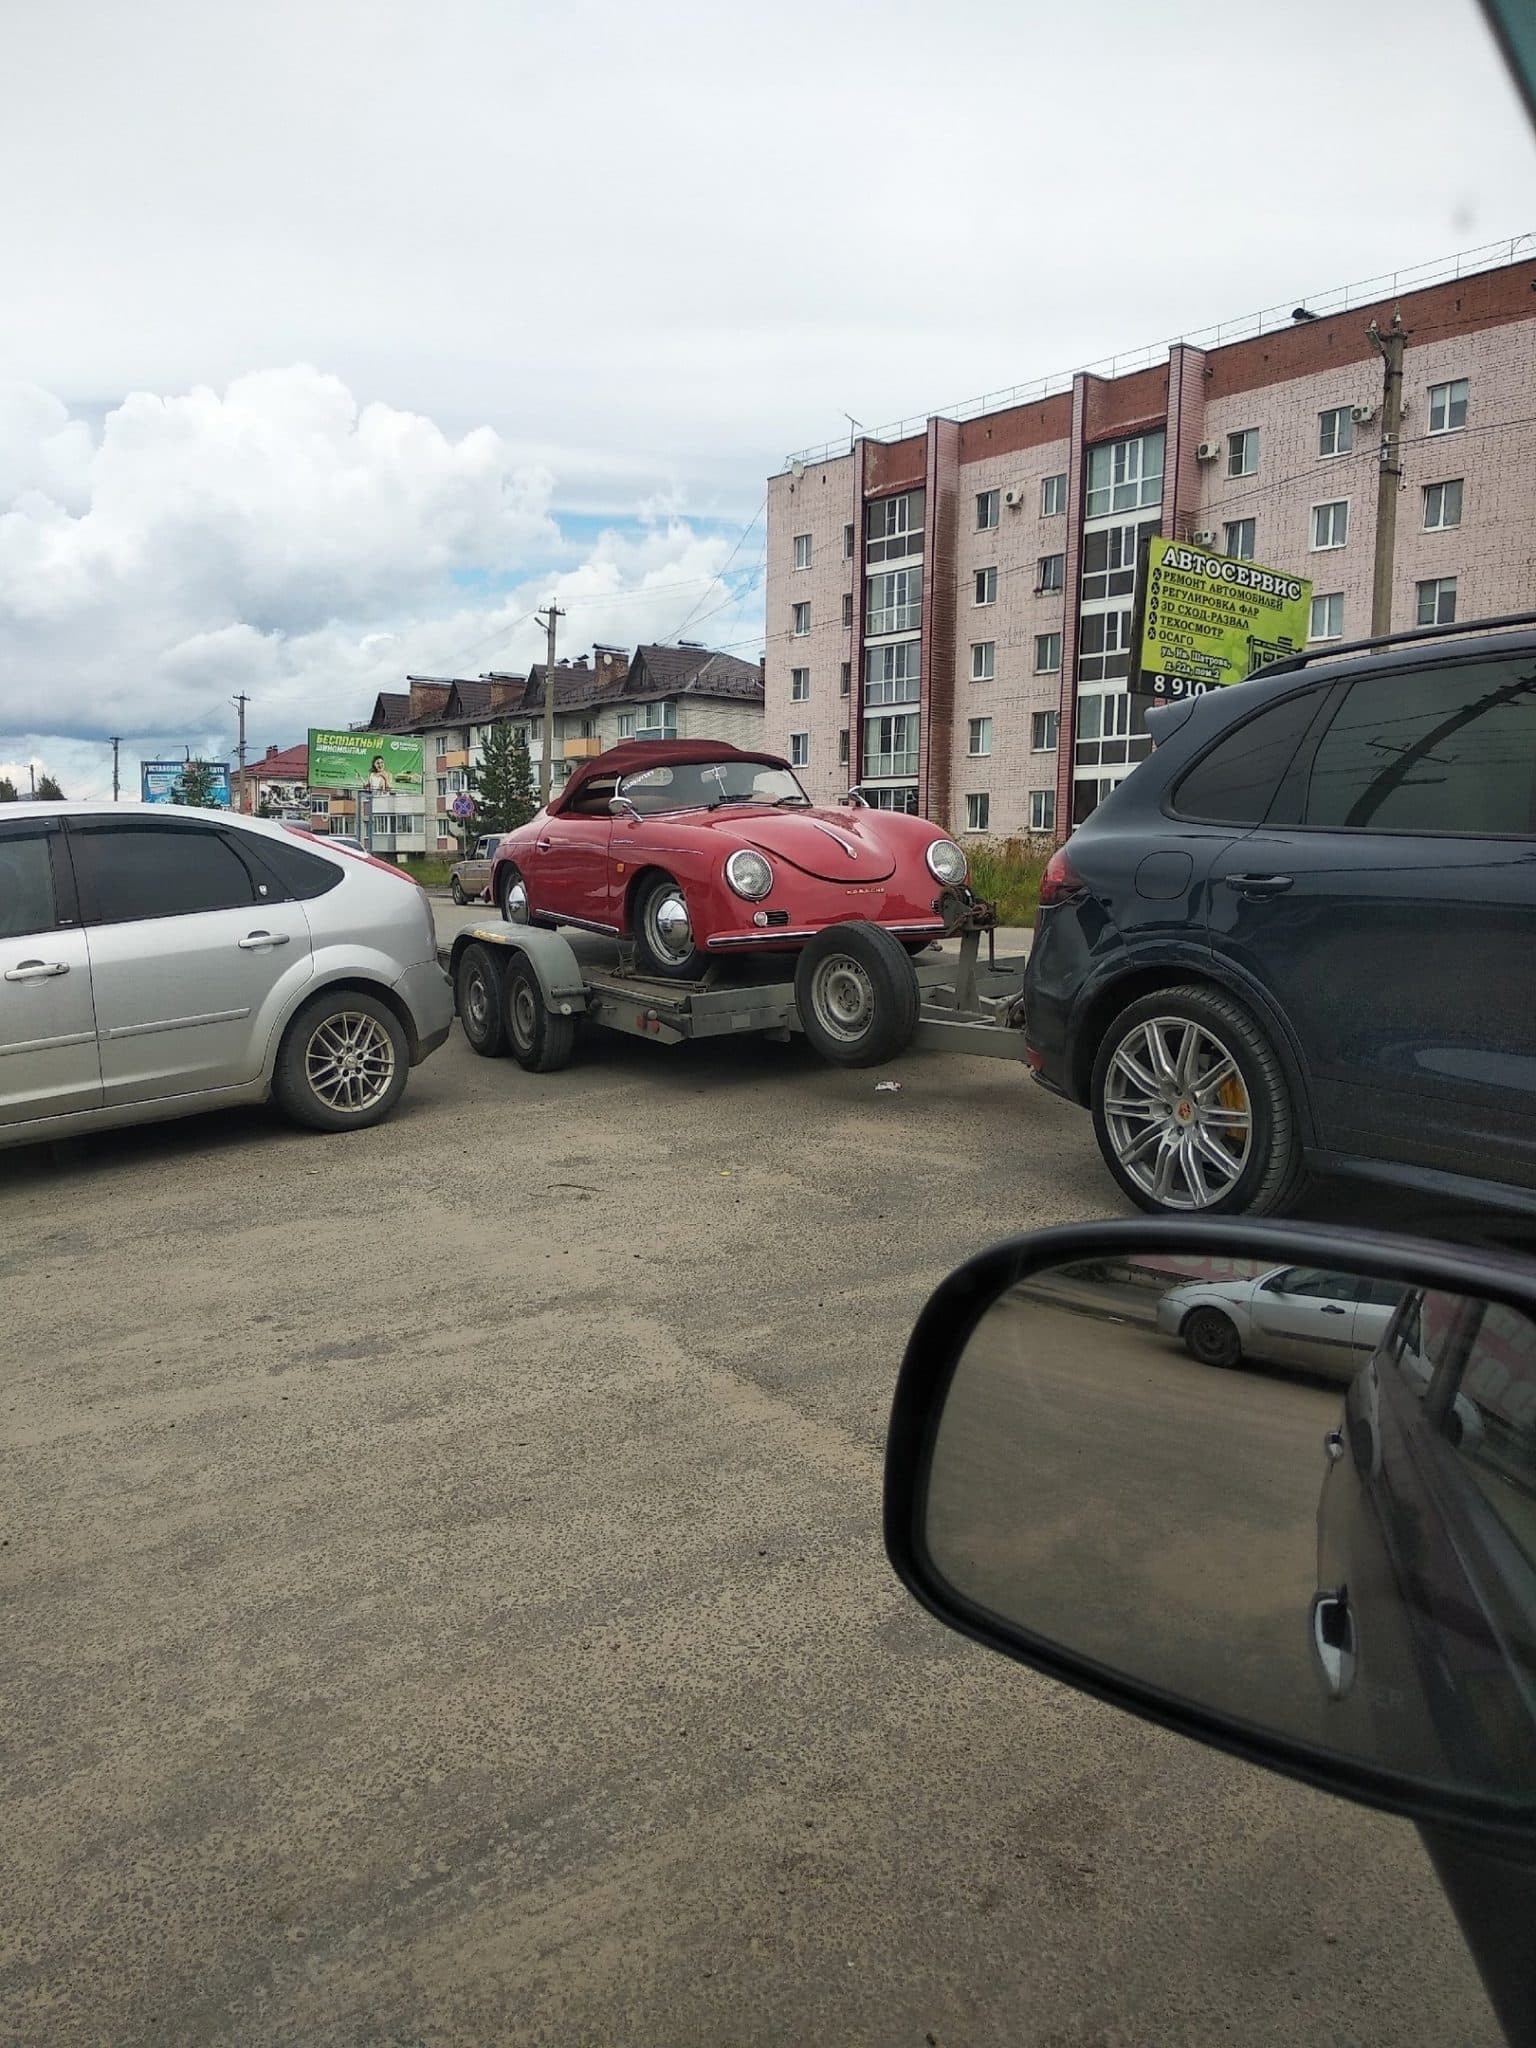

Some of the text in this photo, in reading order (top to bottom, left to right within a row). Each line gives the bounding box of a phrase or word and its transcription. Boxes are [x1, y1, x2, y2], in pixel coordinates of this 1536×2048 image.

[1162, 547, 1301, 600] АВТОСЕРВИС
[1163, 571, 1284, 609] РЕМОНТ АВТОМОБИЛЕЙ
[1162, 586, 1260, 617] РЕГУЛИРОВКА ФАР
[1160, 615, 1224, 637] ТЕХОСМОТР
[1161, 601, 1249, 629] 3D СХОД-РАЗВАЛ
[1159, 630, 1194, 646] ОСАГО
[1154, 675, 1165, 692] 8
[316, 734, 384, 749] БЕСПЛАТНЫЙ
[316, 744, 367, 755] ШИНОМОНТАЖ
